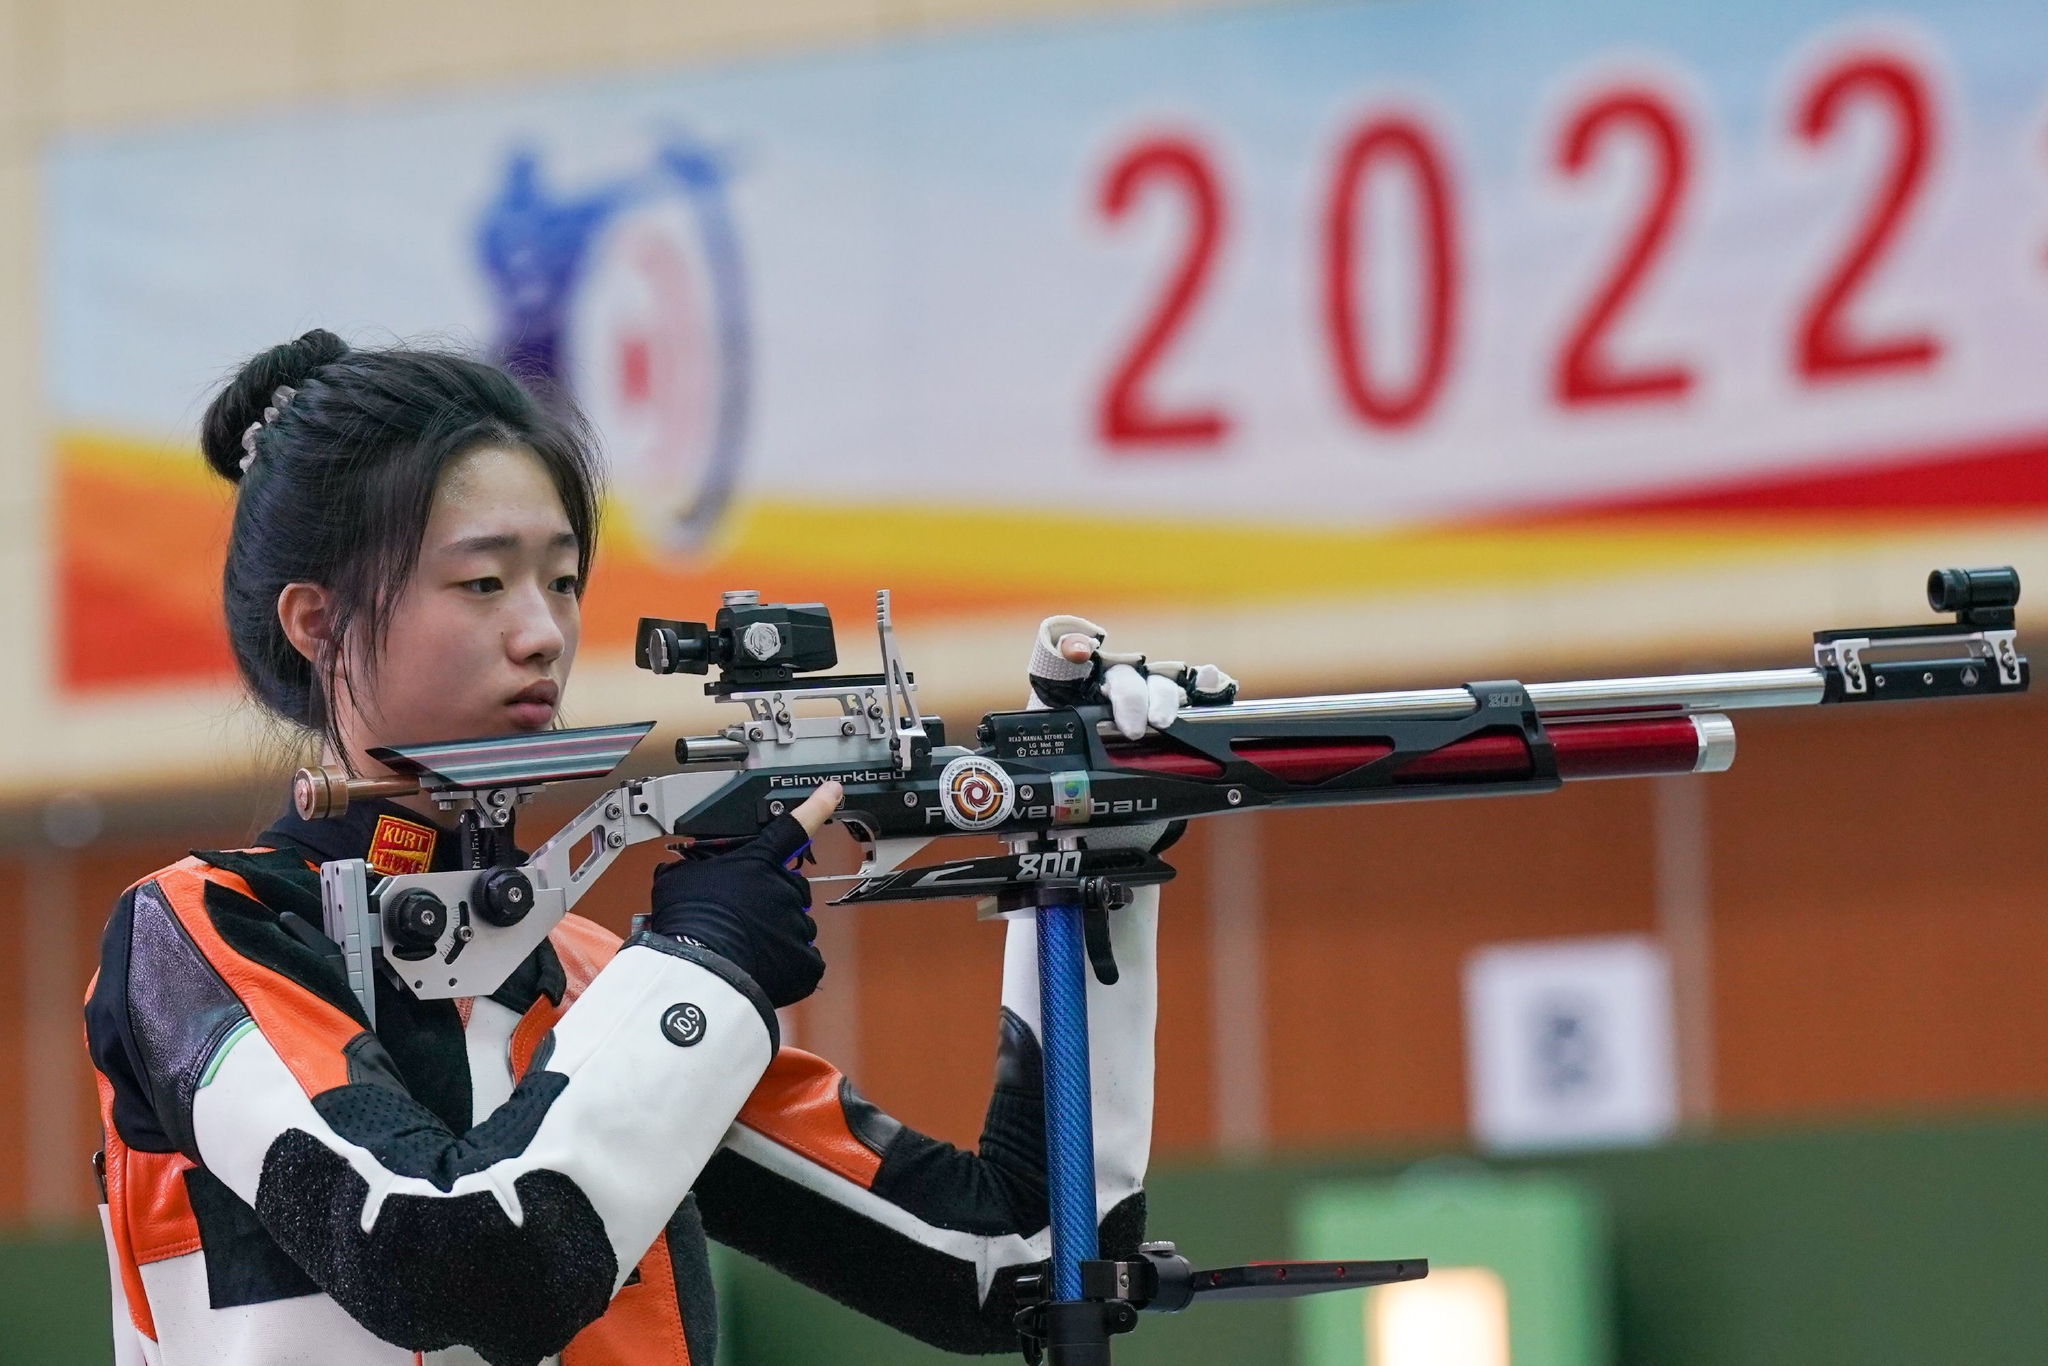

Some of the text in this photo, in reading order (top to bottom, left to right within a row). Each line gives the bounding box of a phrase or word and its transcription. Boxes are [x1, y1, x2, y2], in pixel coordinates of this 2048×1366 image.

[1098, 54, 1942, 450] 2022
[1488, 692, 1523, 707] 800
[769, 770, 906, 788] Feinwerkbau
[382, 824, 429, 850] KURT
[1015, 851, 1082, 880] 800
